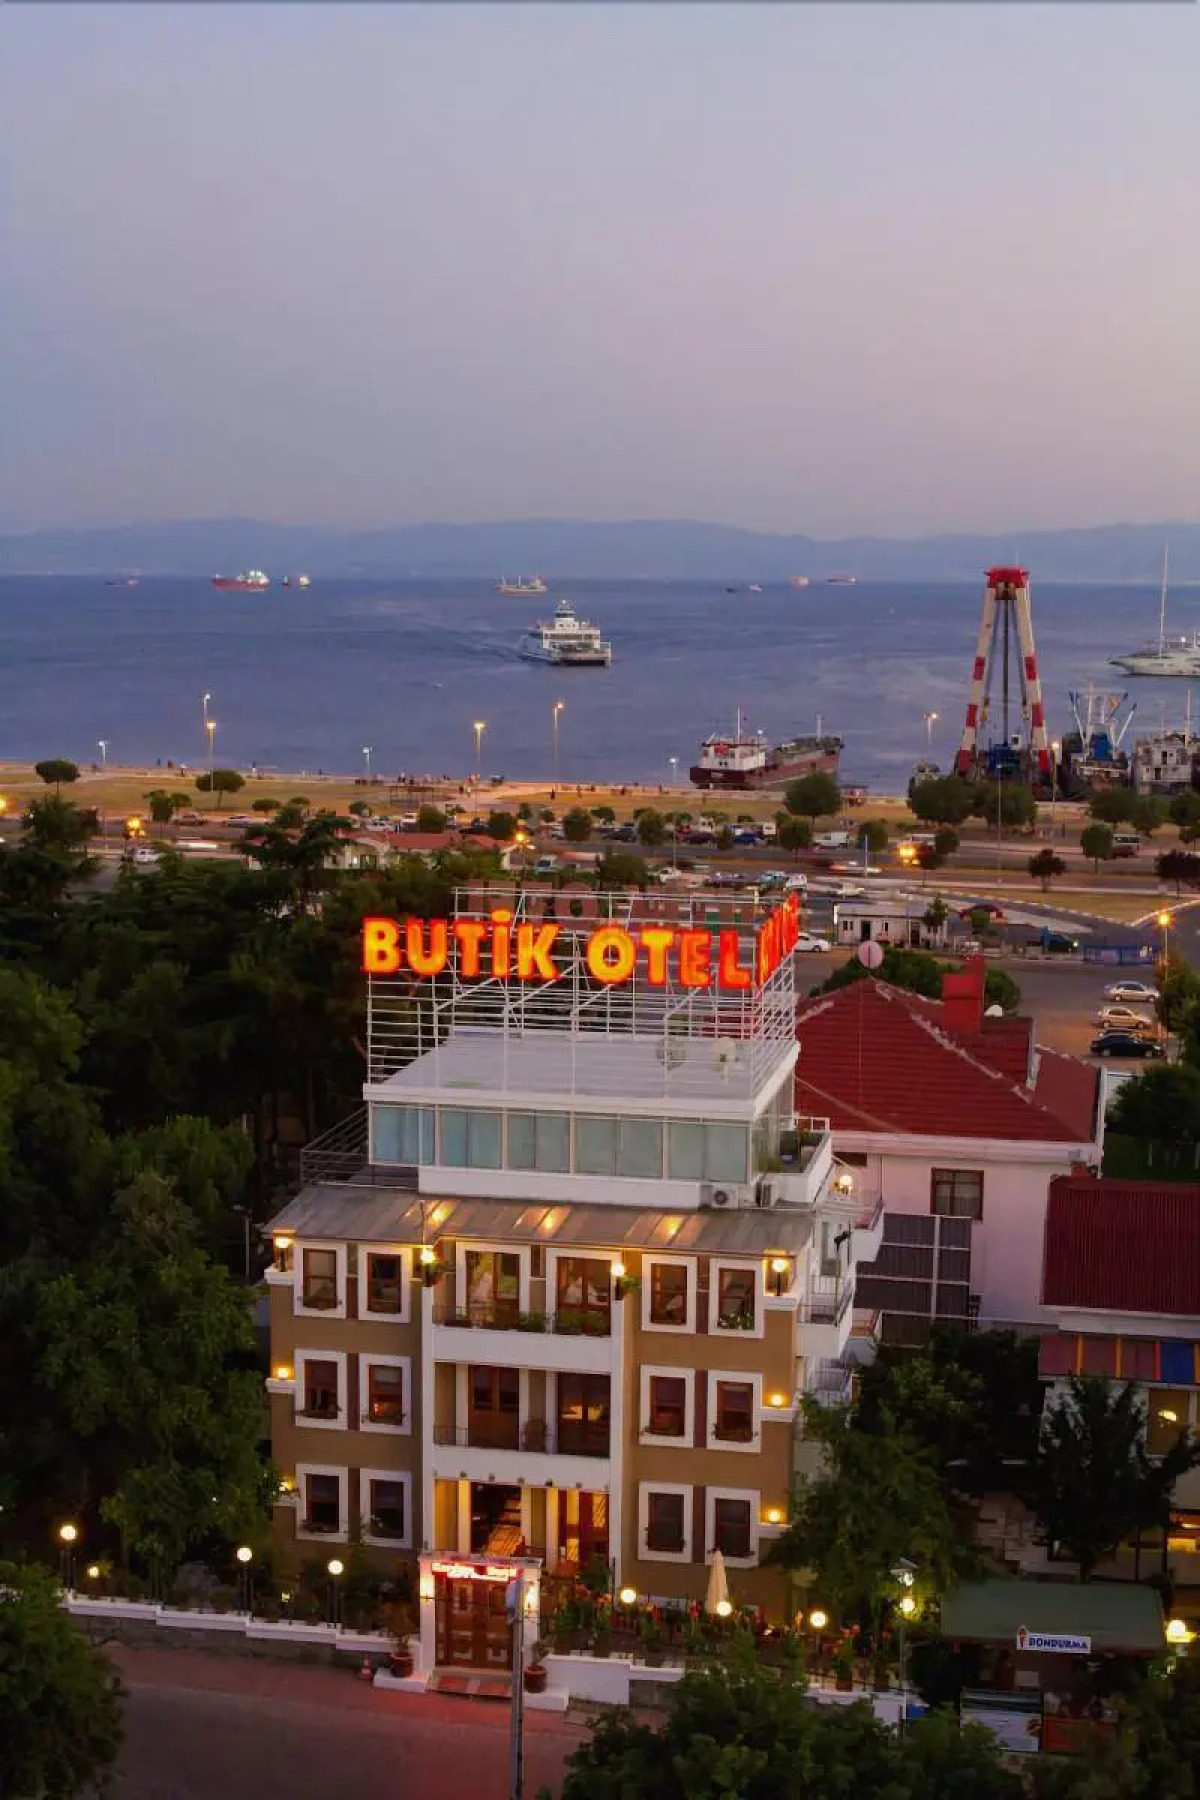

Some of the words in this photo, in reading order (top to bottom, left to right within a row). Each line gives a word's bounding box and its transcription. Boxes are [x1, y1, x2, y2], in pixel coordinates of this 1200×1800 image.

[363, 909, 562, 979] BUTİK
[586, 923, 754, 988] OTEL
[1028, 1637, 1088, 1649] DONDURMA
